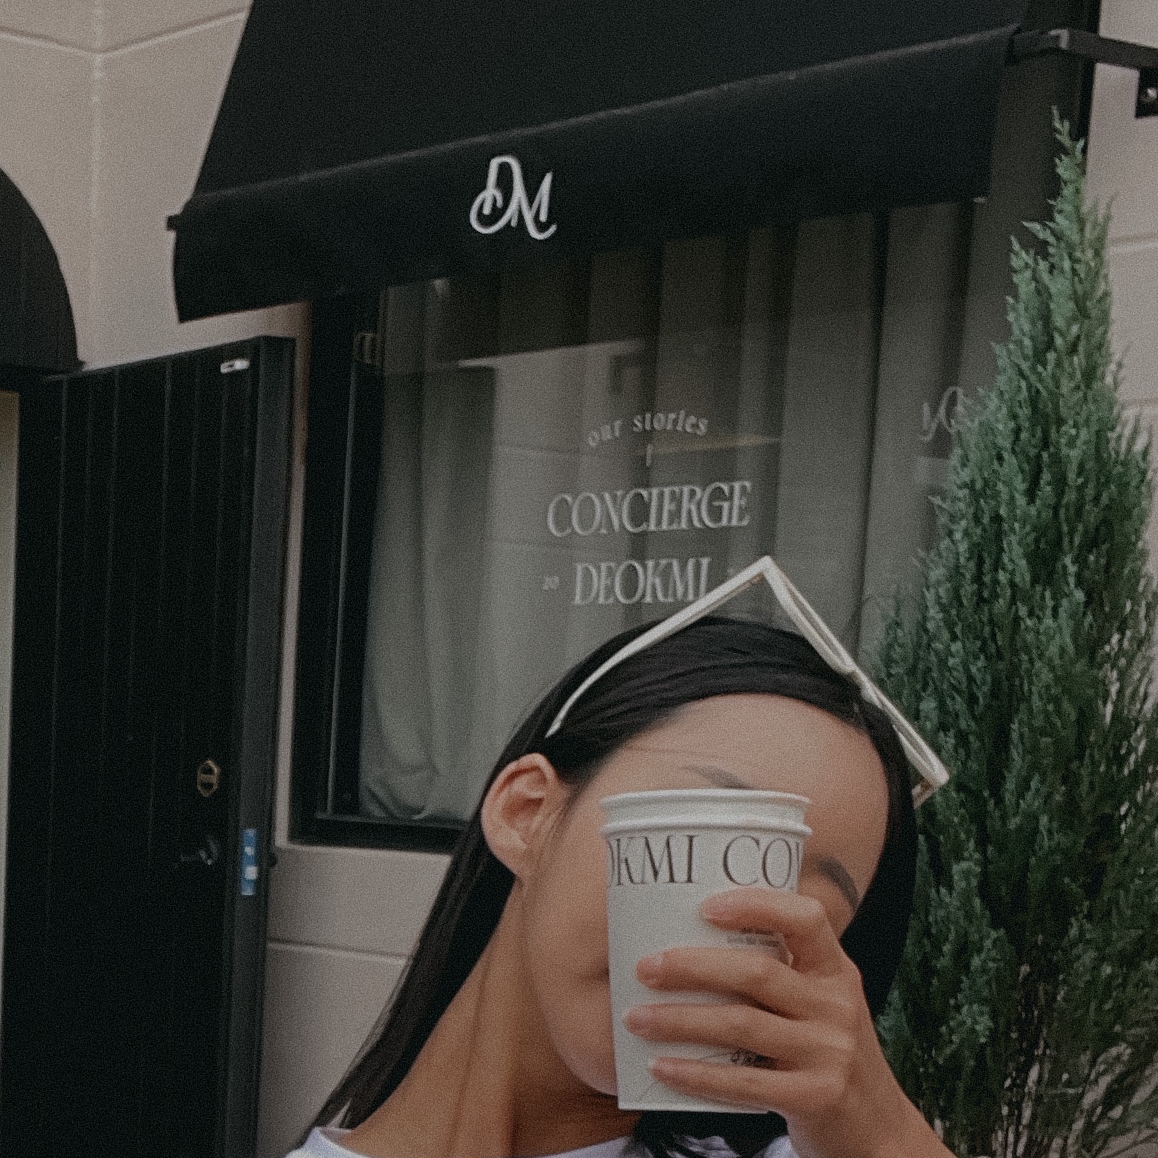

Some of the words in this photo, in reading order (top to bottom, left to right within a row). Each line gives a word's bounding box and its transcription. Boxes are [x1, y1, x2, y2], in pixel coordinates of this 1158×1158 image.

[587, 418, 623, 447] our
[632, 409, 709, 437] stories
[546, 480, 752, 538] CONCIERGE
[573, 556, 713, 606] DEOKMI
